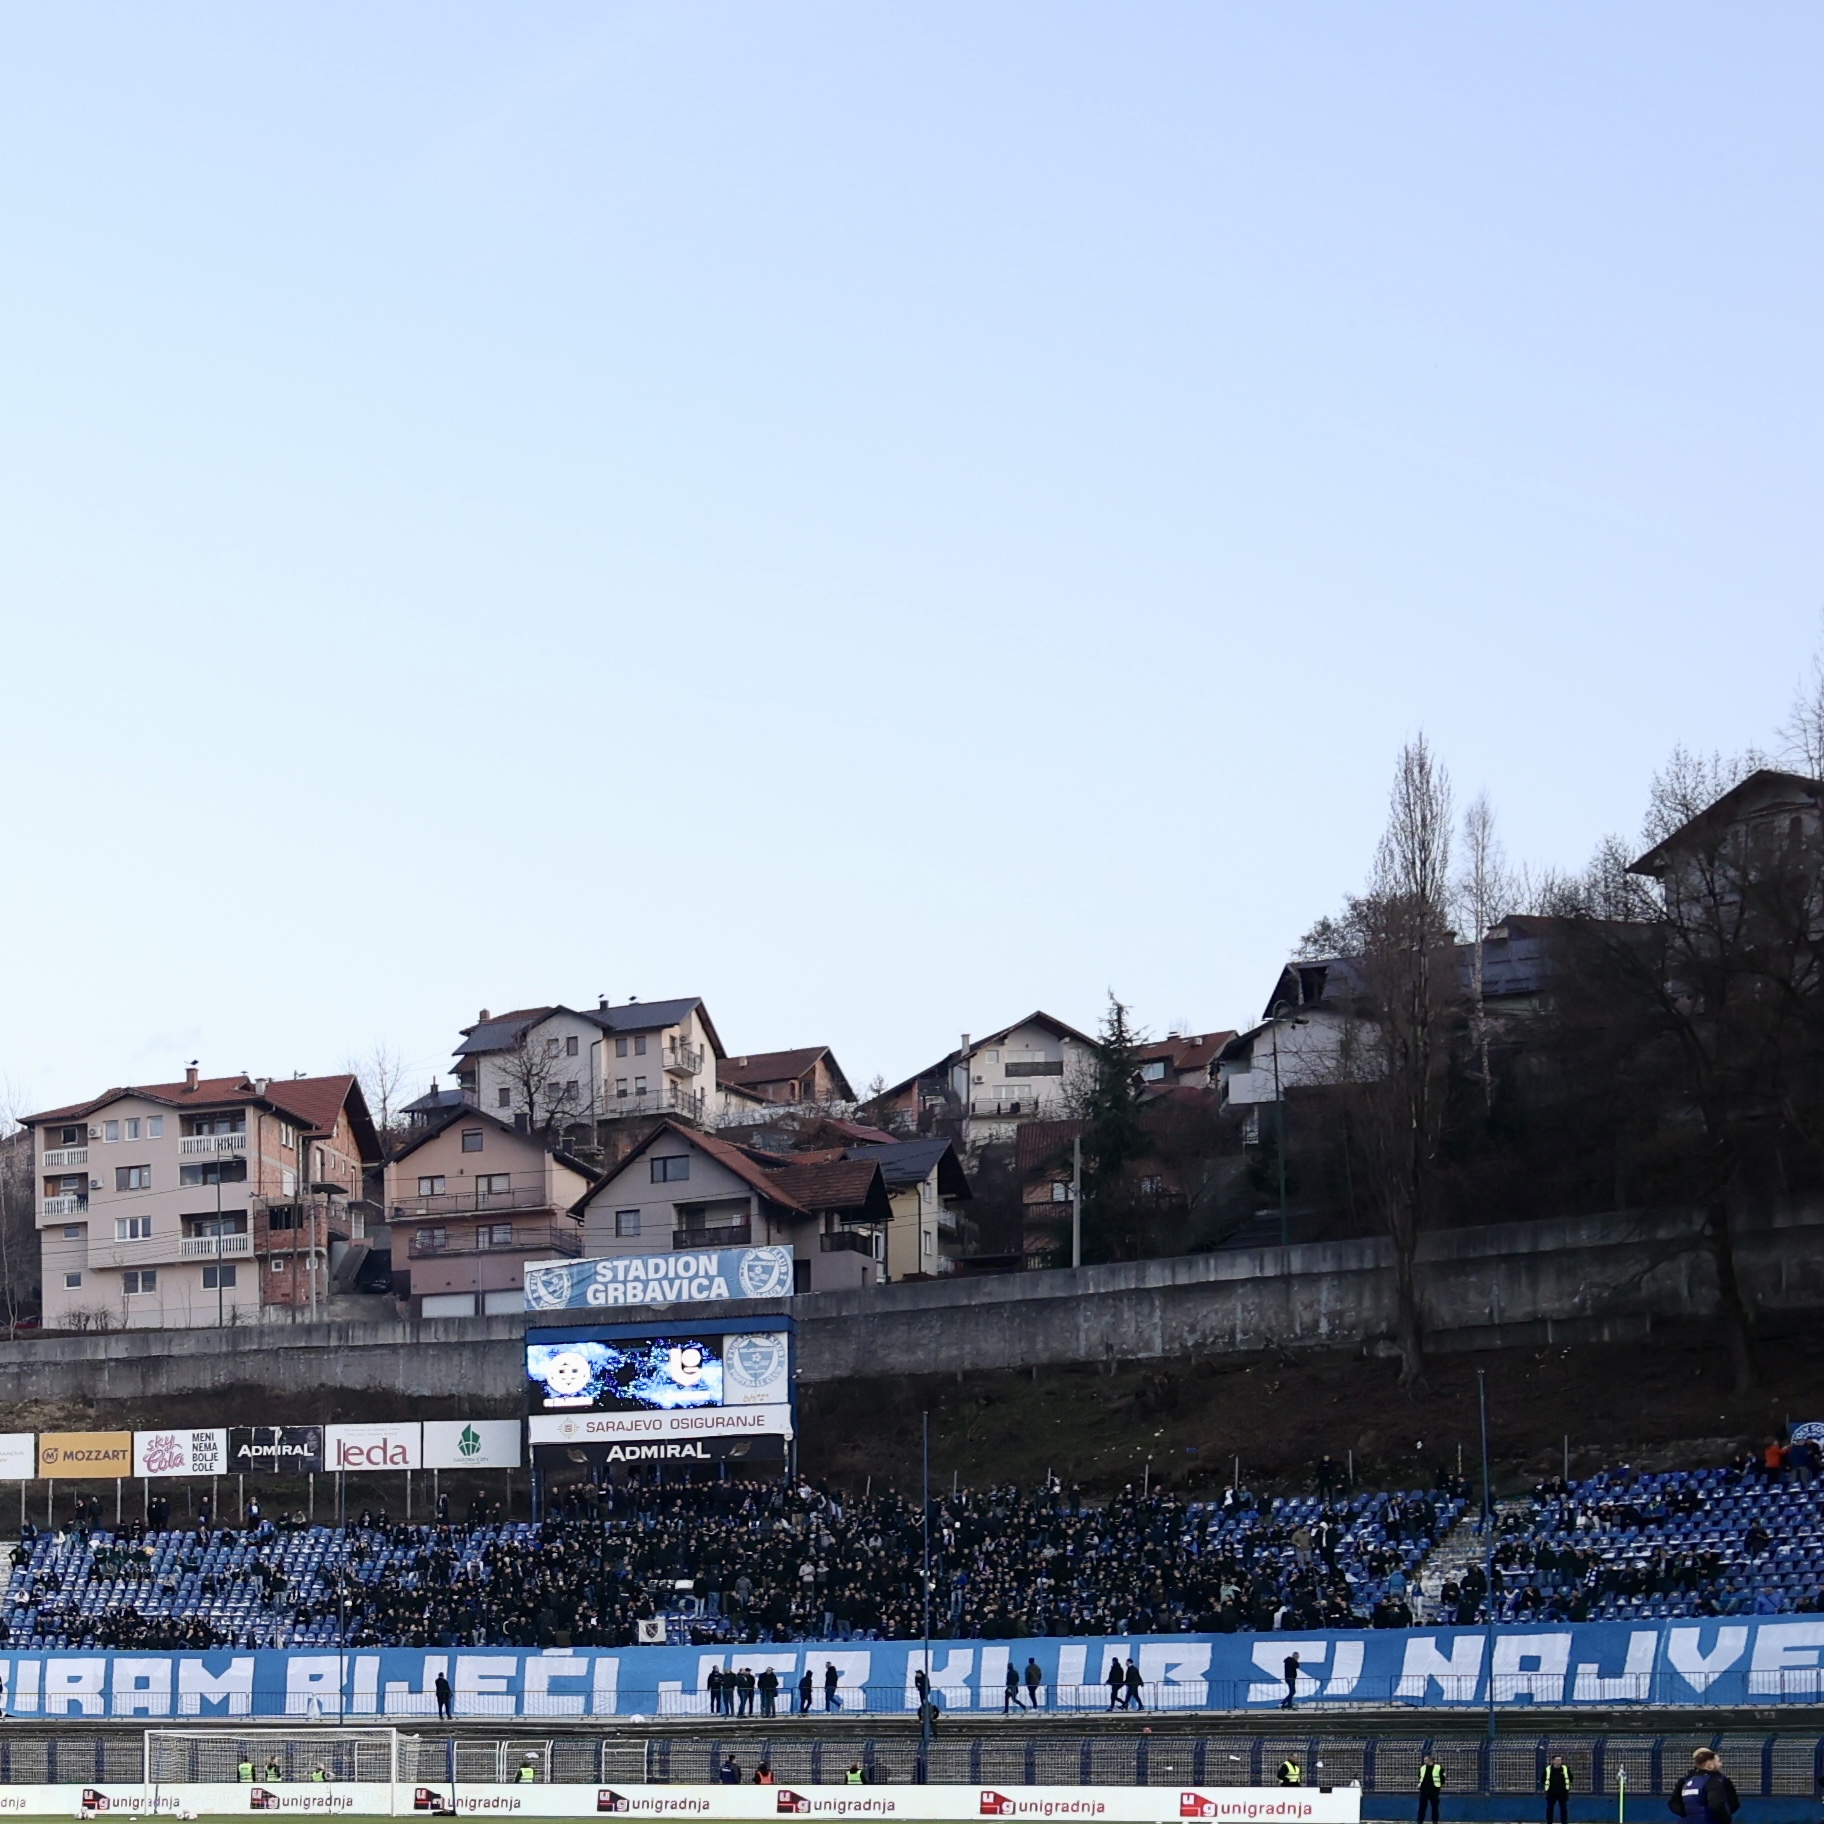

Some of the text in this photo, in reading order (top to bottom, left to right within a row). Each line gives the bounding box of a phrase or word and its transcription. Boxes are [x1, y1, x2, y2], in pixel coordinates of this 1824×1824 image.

[596, 1255, 718, 1283] STADION
[586, 1277, 729, 1305] GRBAVICA
[586, 1415, 765, 1433] SARAJEVO OSIGURANJE
[192, 1433, 214, 1442] MENI
[192, 1442, 218, 1451] NEMA
[238, 1443, 314, 1458] ADMIRAL
[336, 1437, 410, 1466] leda
[606, 1442, 711, 1462] ADMIRAL
[62, 1449, 128, 1462] MOZZART
[192, 1452, 219, 1462] BOLJE
[192, 1462, 214, 1472] COLE
[904, 1642, 1212, 1710] KLUB
[1247, 1640, 1364, 1702] SI
[110, 1795, 180, 1811] unigradnja
[282, 1794, 353, 1811] unigradnja
[447, 1796, 521, 1812] unigradnja
[631, 1797, 710, 1813] unigradnja
[813, 1798, 895, 1814] unigradnja
[1018, 1799, 1105, 1817] unigradnja
[1220, 1801, 1312, 1818] unigradnja
